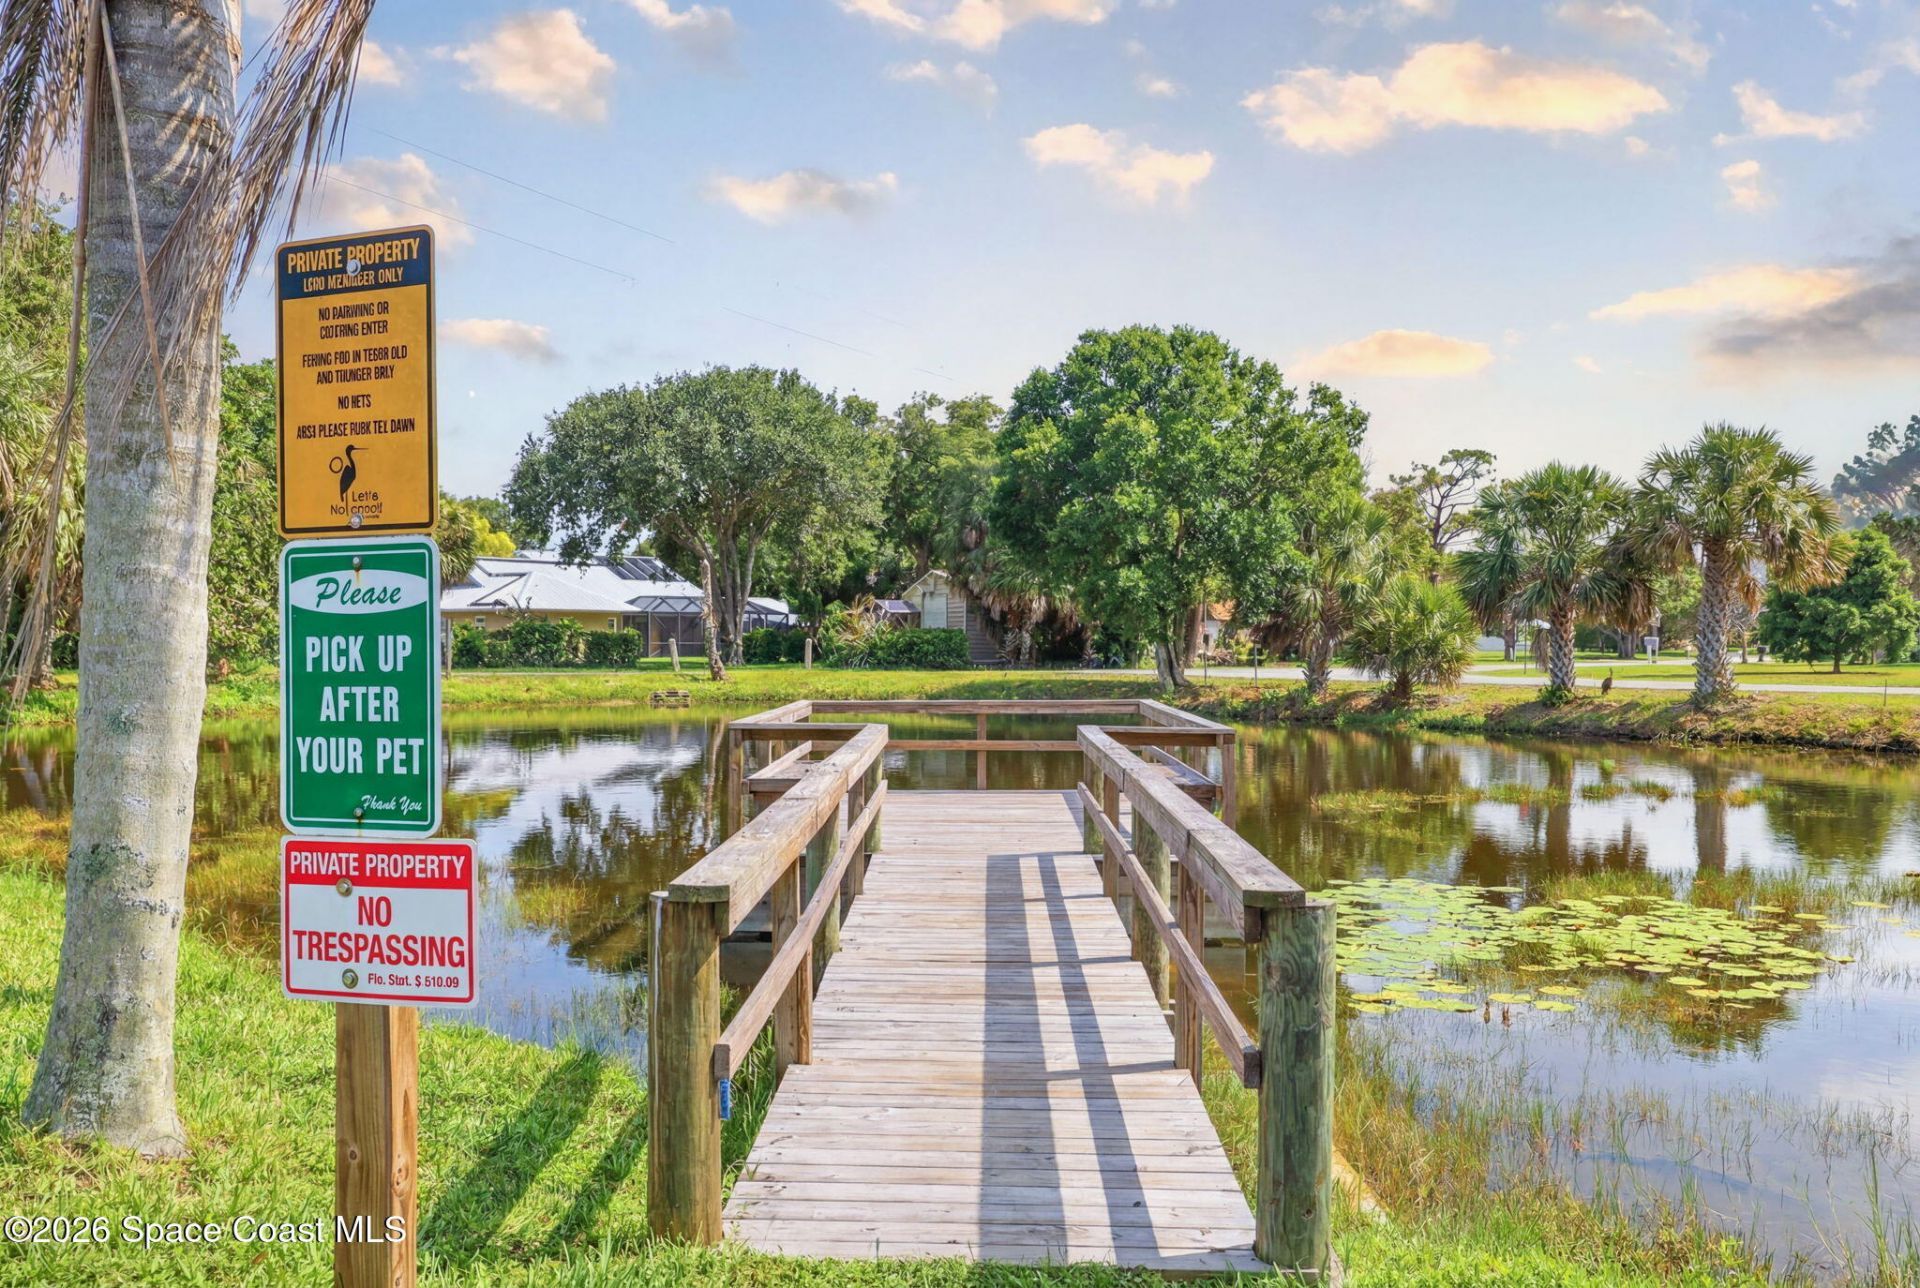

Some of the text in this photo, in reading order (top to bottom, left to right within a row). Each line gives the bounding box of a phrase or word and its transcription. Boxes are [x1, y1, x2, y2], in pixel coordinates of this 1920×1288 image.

[288, 238, 419, 274] PRIVATE PROPERTY
[379, 267, 403, 283] ONLY
[319, 308, 330, 320] NO
[378, 302, 388, 314] OR
[362, 320, 388, 335] ENTER
[353, 350, 360, 362] IN
[317, 371, 333, 384] AND
[338, 396, 349, 409] NO
[319, 423, 348, 438] PLEASE
[390, 418, 415, 433] DAWN
[316, 577, 402, 608] Please
[306, 635, 412, 672] PICK UP
[320, 686, 399, 722] AFTER
[296, 737, 424, 775] YOUR PET
[361, 795, 422, 816] Thank You
[291, 852, 465, 879] PRIVATE PROPERTY
[358, 896, 391, 927] NO
[293, 930, 465, 968] TRESPASSING
[425, 975, 459, 987] 510.09
